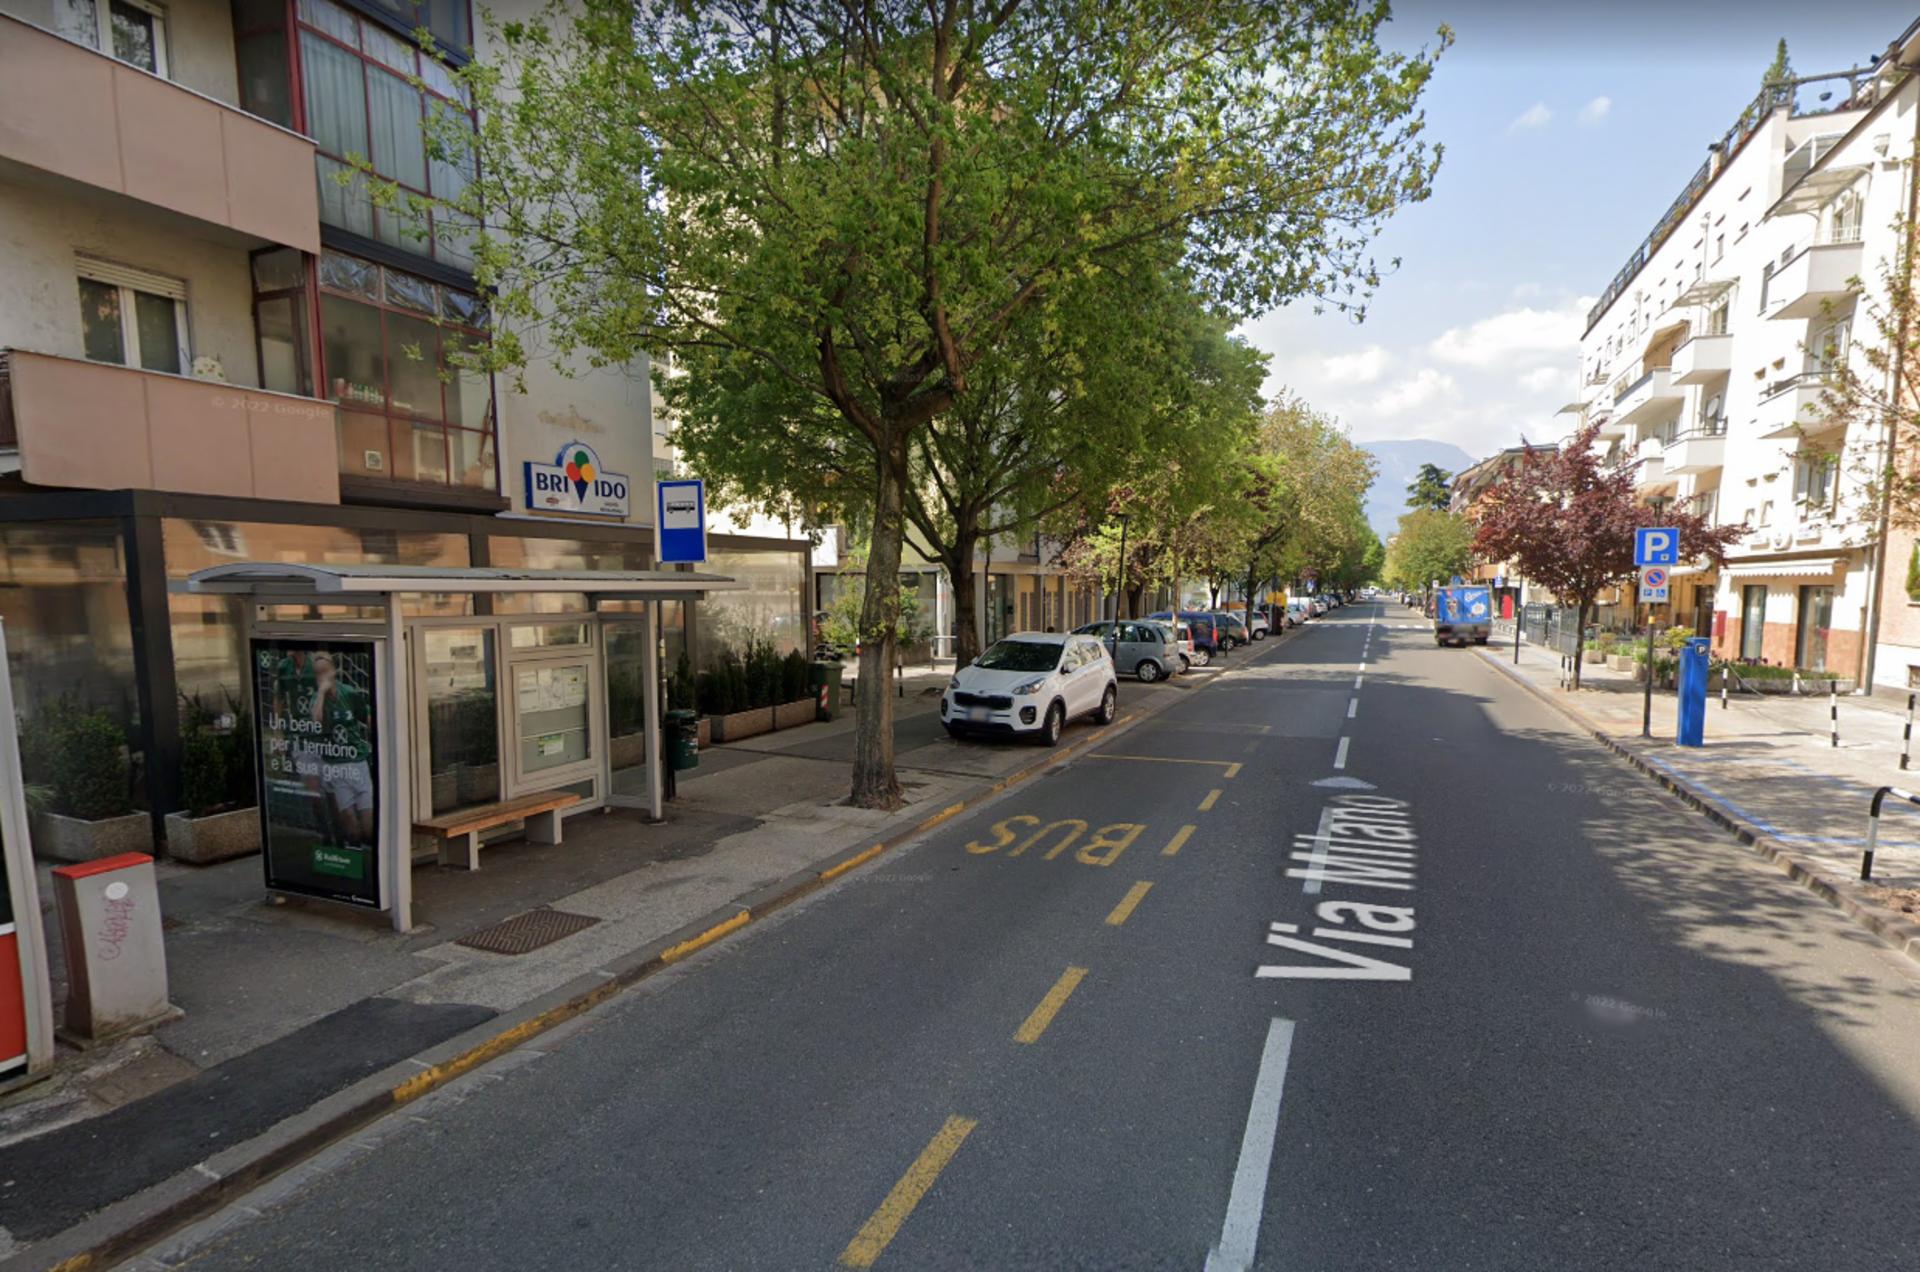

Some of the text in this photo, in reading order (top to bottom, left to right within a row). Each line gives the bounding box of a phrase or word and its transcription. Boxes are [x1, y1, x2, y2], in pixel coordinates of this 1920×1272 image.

[1644, 531, 1670, 562] P
[269, 712, 322, 733] Un bene
[270, 736, 358, 758] per il territorio
[271, 759, 279, 770] e
[282, 755, 293, 772] la
[296, 761, 318, 775] sua
[964, 815, 1147, 866] BUS
[1254, 794, 1418, 981] Via Milano
